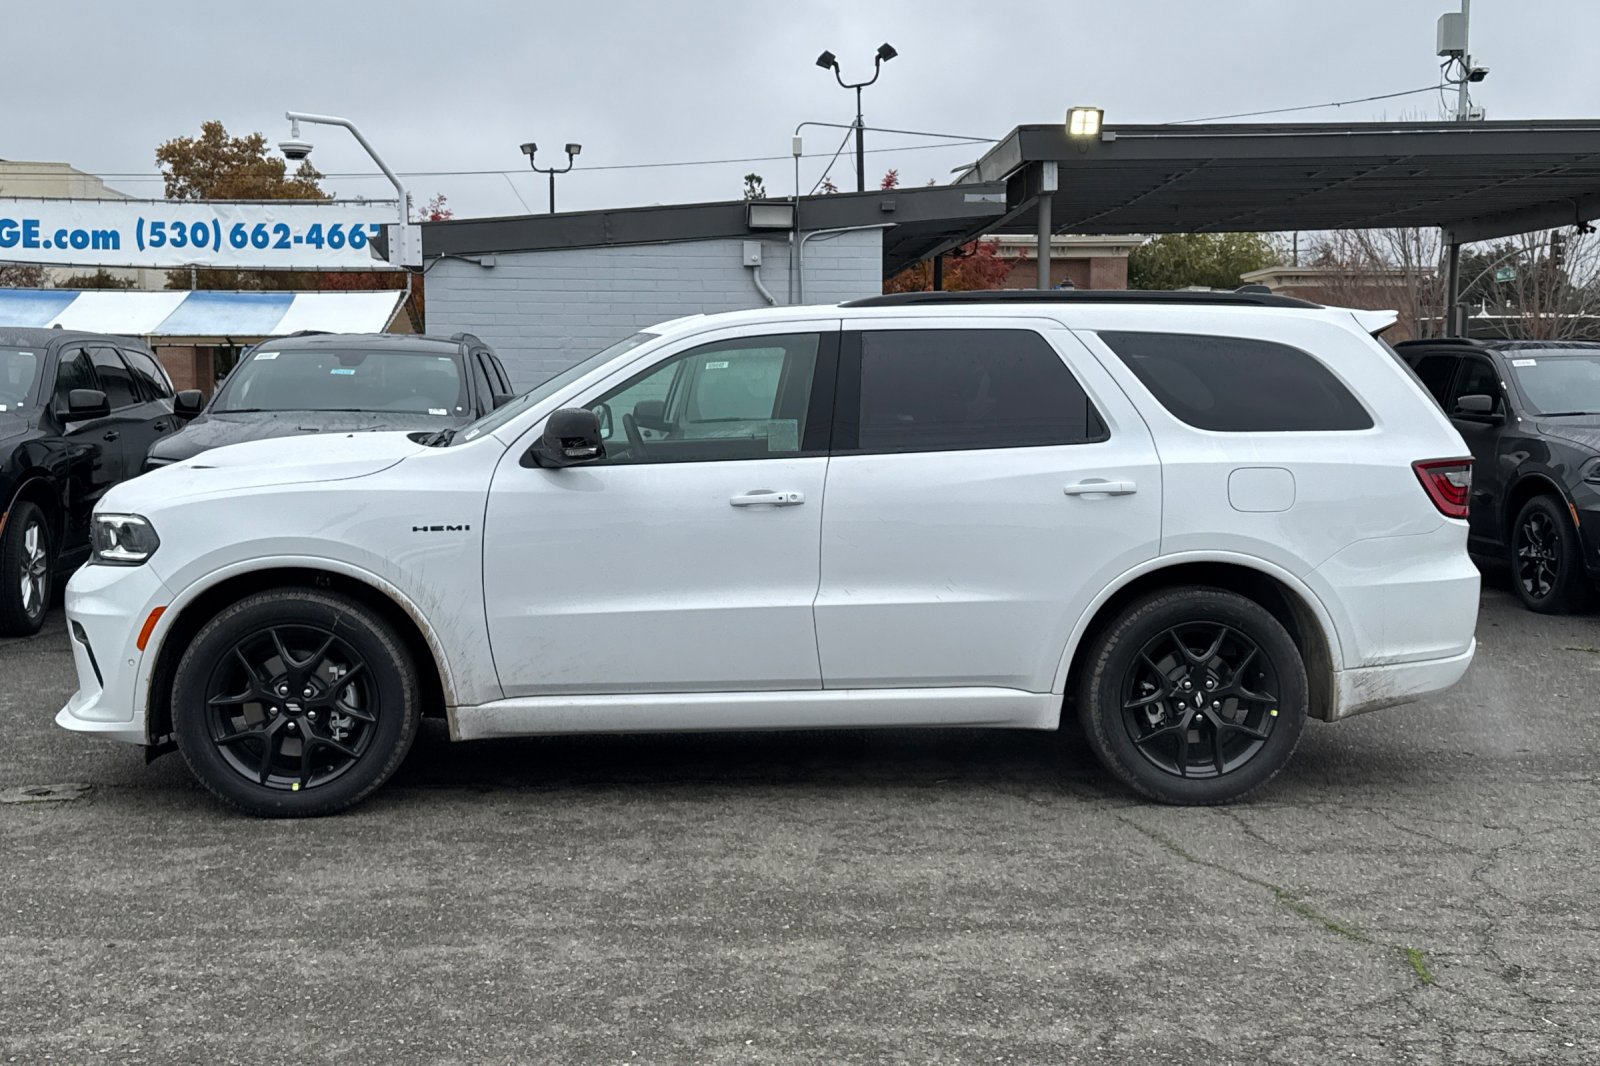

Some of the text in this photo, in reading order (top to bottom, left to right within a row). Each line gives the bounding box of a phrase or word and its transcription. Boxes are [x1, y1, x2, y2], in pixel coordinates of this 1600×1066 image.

[0, 218, 121, 250] GE.com
[136, 216, 222, 253] (530)
[412, 524, 470, 532] HEMI
